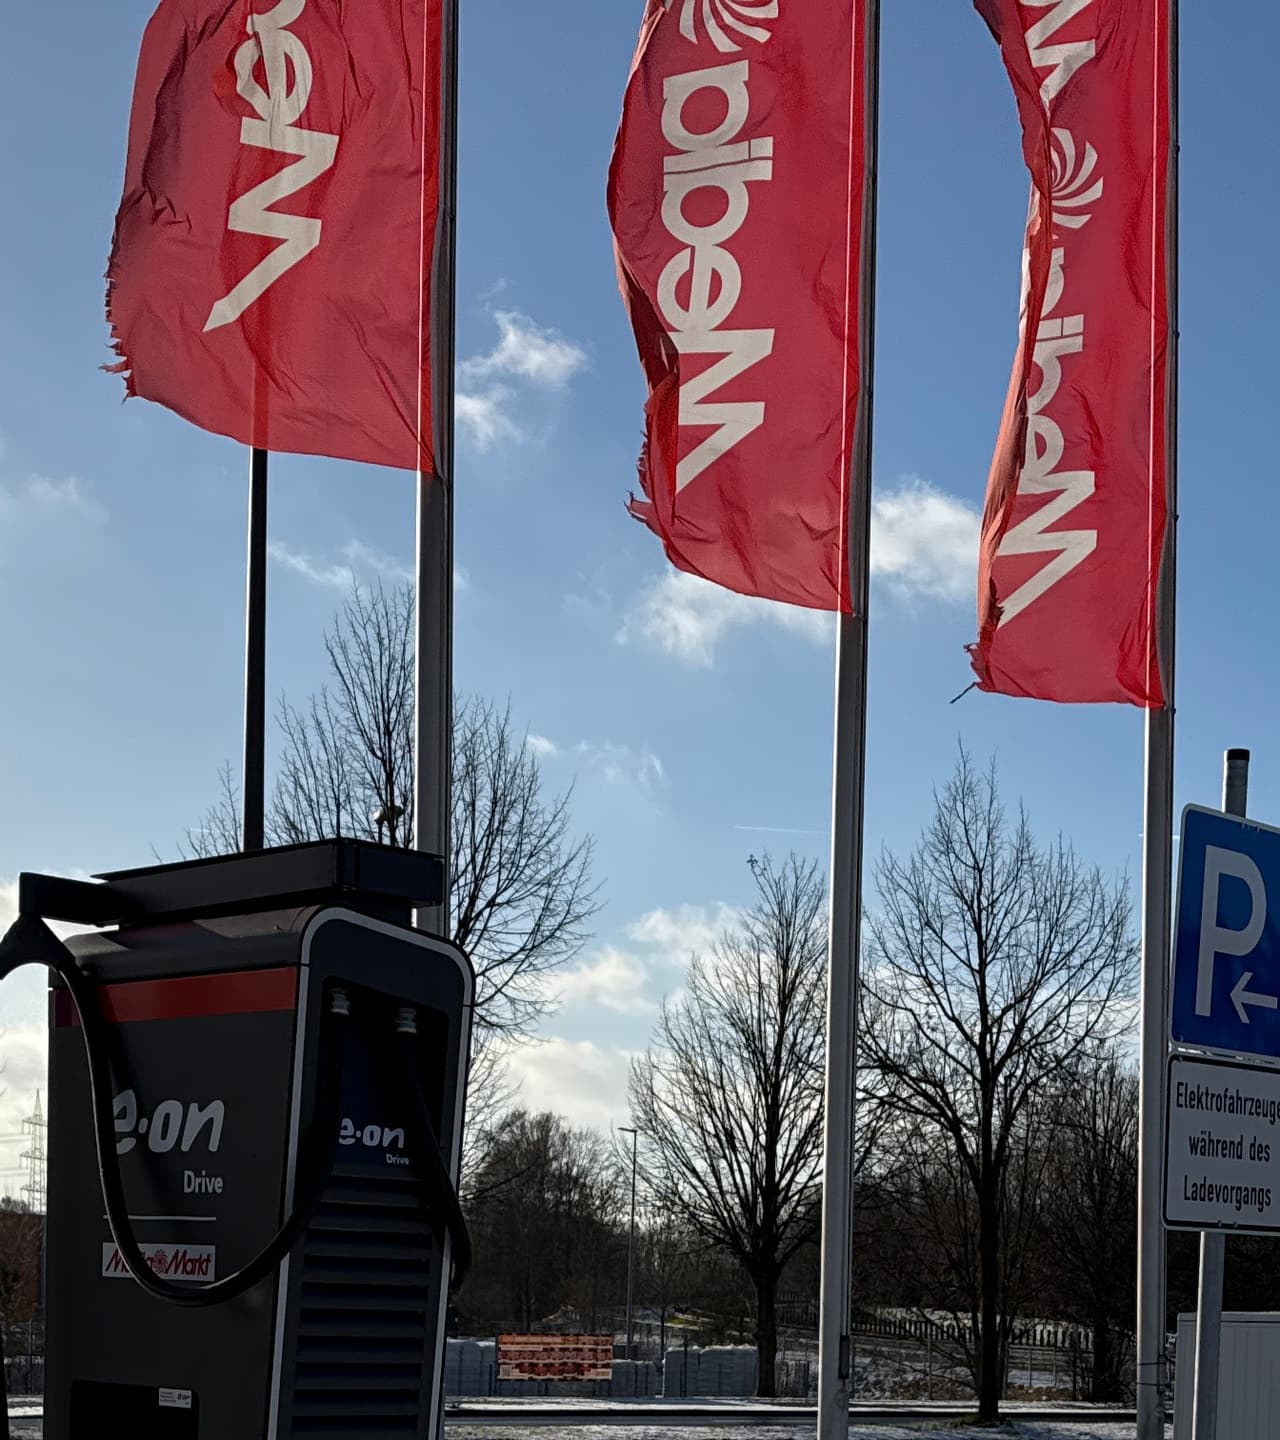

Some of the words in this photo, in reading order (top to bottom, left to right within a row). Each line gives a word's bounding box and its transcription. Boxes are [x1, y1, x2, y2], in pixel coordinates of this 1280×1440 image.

[1195, 845, 1267, 1017] P
[385, 1153, 410, 1166] Drive
[1188, 1130, 1244, 1160] während
[1249, 1135, 1271, 1162] des
[183, 1170, 224, 1194] Drive
[1183, 1174, 1272, 1212] Ladevorgangs
[165, 1249, 212, 1276] Markt
